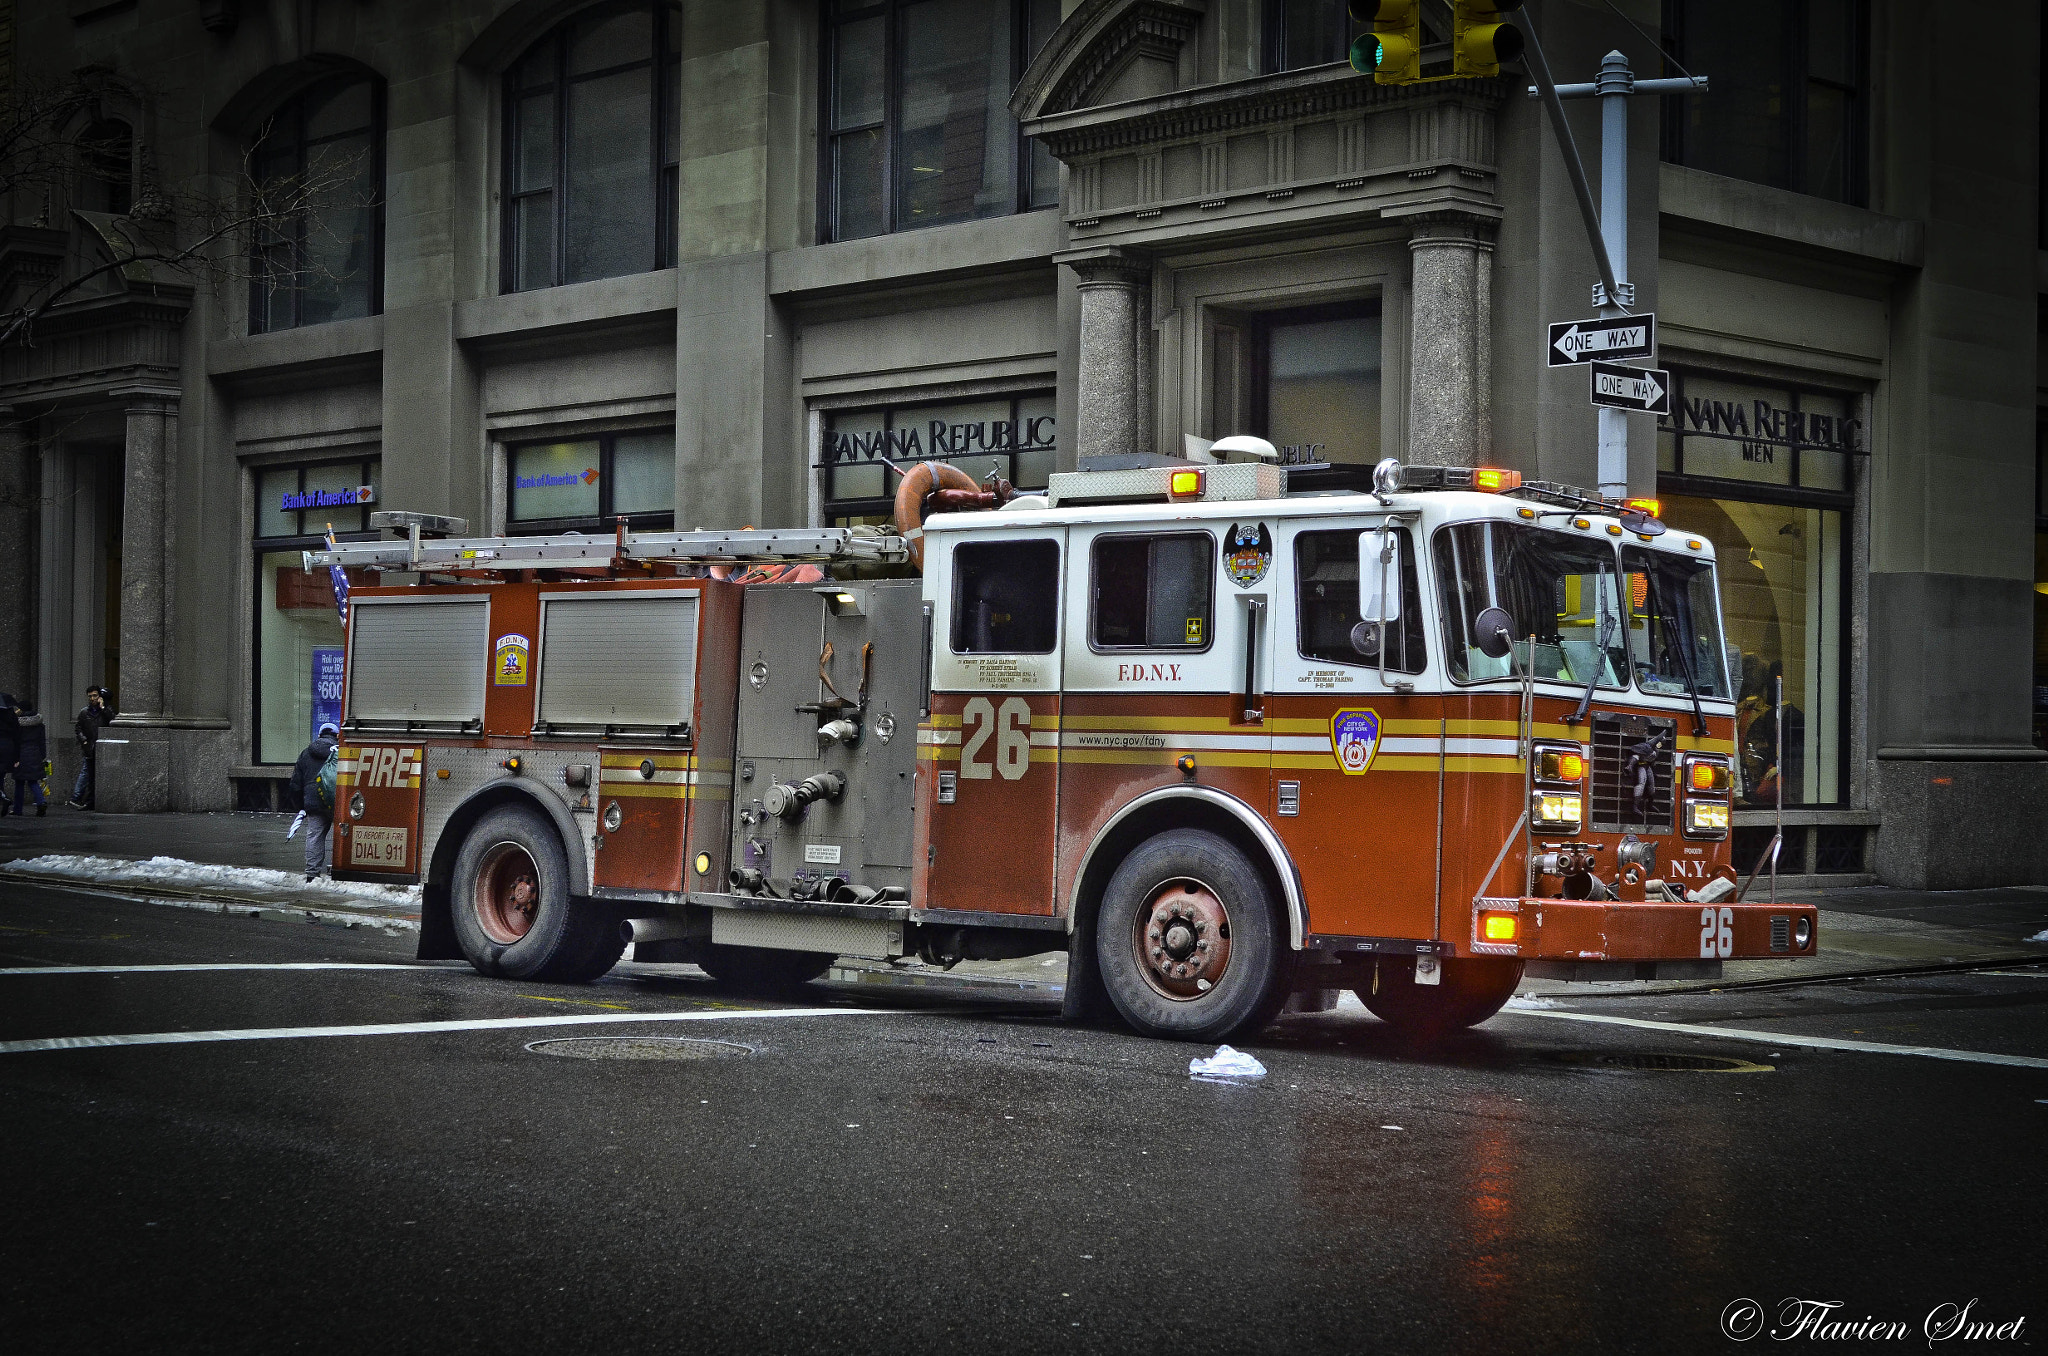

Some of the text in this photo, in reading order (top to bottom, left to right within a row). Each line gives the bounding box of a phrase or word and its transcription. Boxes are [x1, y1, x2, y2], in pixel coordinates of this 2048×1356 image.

[1564, 329, 1640, 352] ONE WAY
[1601, 376, 1656, 399] ONE WAY
[1658, 395, 1862, 449] ANANA REPUBLIC
[822, 415, 1056, 464] BANANA REPUBLIC
[1742, 443, 1774, 464] MEN
[516, 472, 578, 489] Bank of America
[281, 487, 356, 510] Bank of America
[321, 654, 344, 664] Roll over
[321, 664, 344, 674] your IRA
[1118, 663, 1182, 682] F.D.N.Y.
[317, 681, 344, 700] $600
[960, 697, 1031, 780] 26
[1078, 734, 1166, 748] www.nyc.gov/fdny
[353, 747, 415, 788] FIRE
[355, 830, 362, 838] TO
[363, 831, 385, 840] REPORT
[392, 833, 404, 841] FIRE
[355, 842, 403, 861] DIAL 911
[1671, 860, 1711, 878] N.Y.
[1700, 907, 1734, 958] 26
